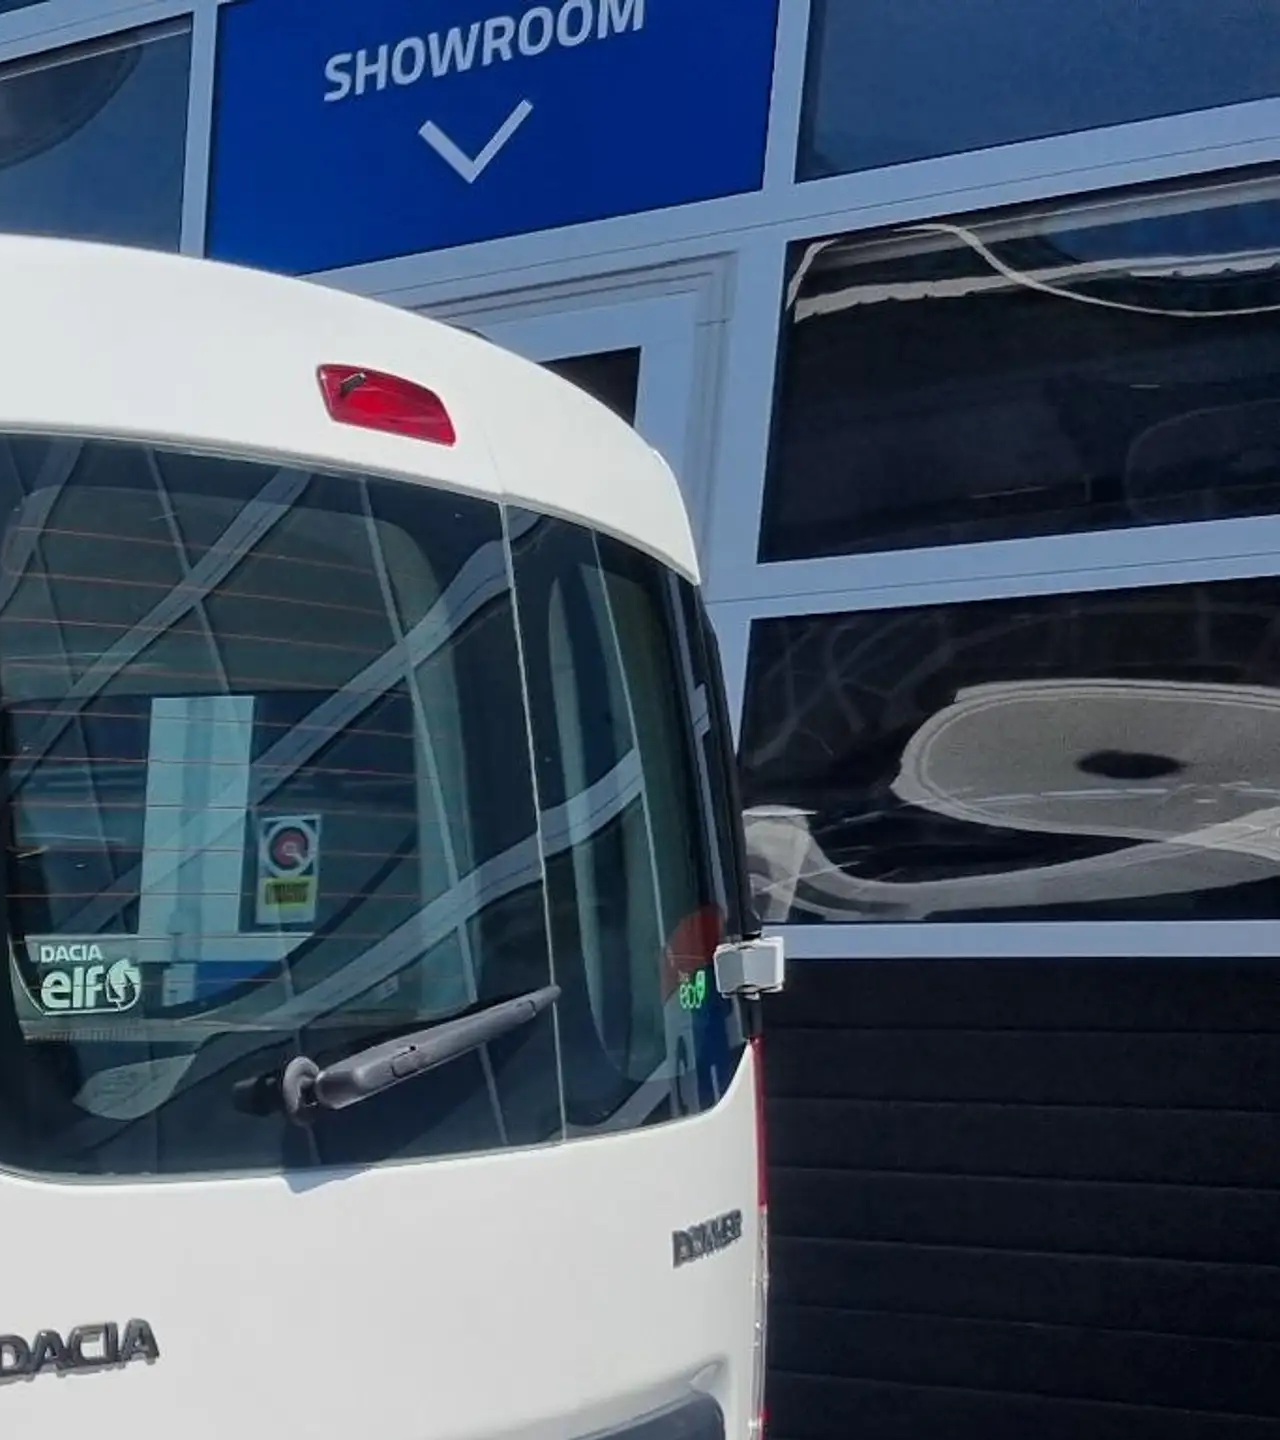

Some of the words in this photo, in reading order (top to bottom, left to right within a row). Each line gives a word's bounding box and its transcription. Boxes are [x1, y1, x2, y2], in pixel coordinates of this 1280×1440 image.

[324, 0, 645, 101] SHOWROOM
[40, 944, 103, 963] DACIA
[41, 965, 104, 1009] elf
